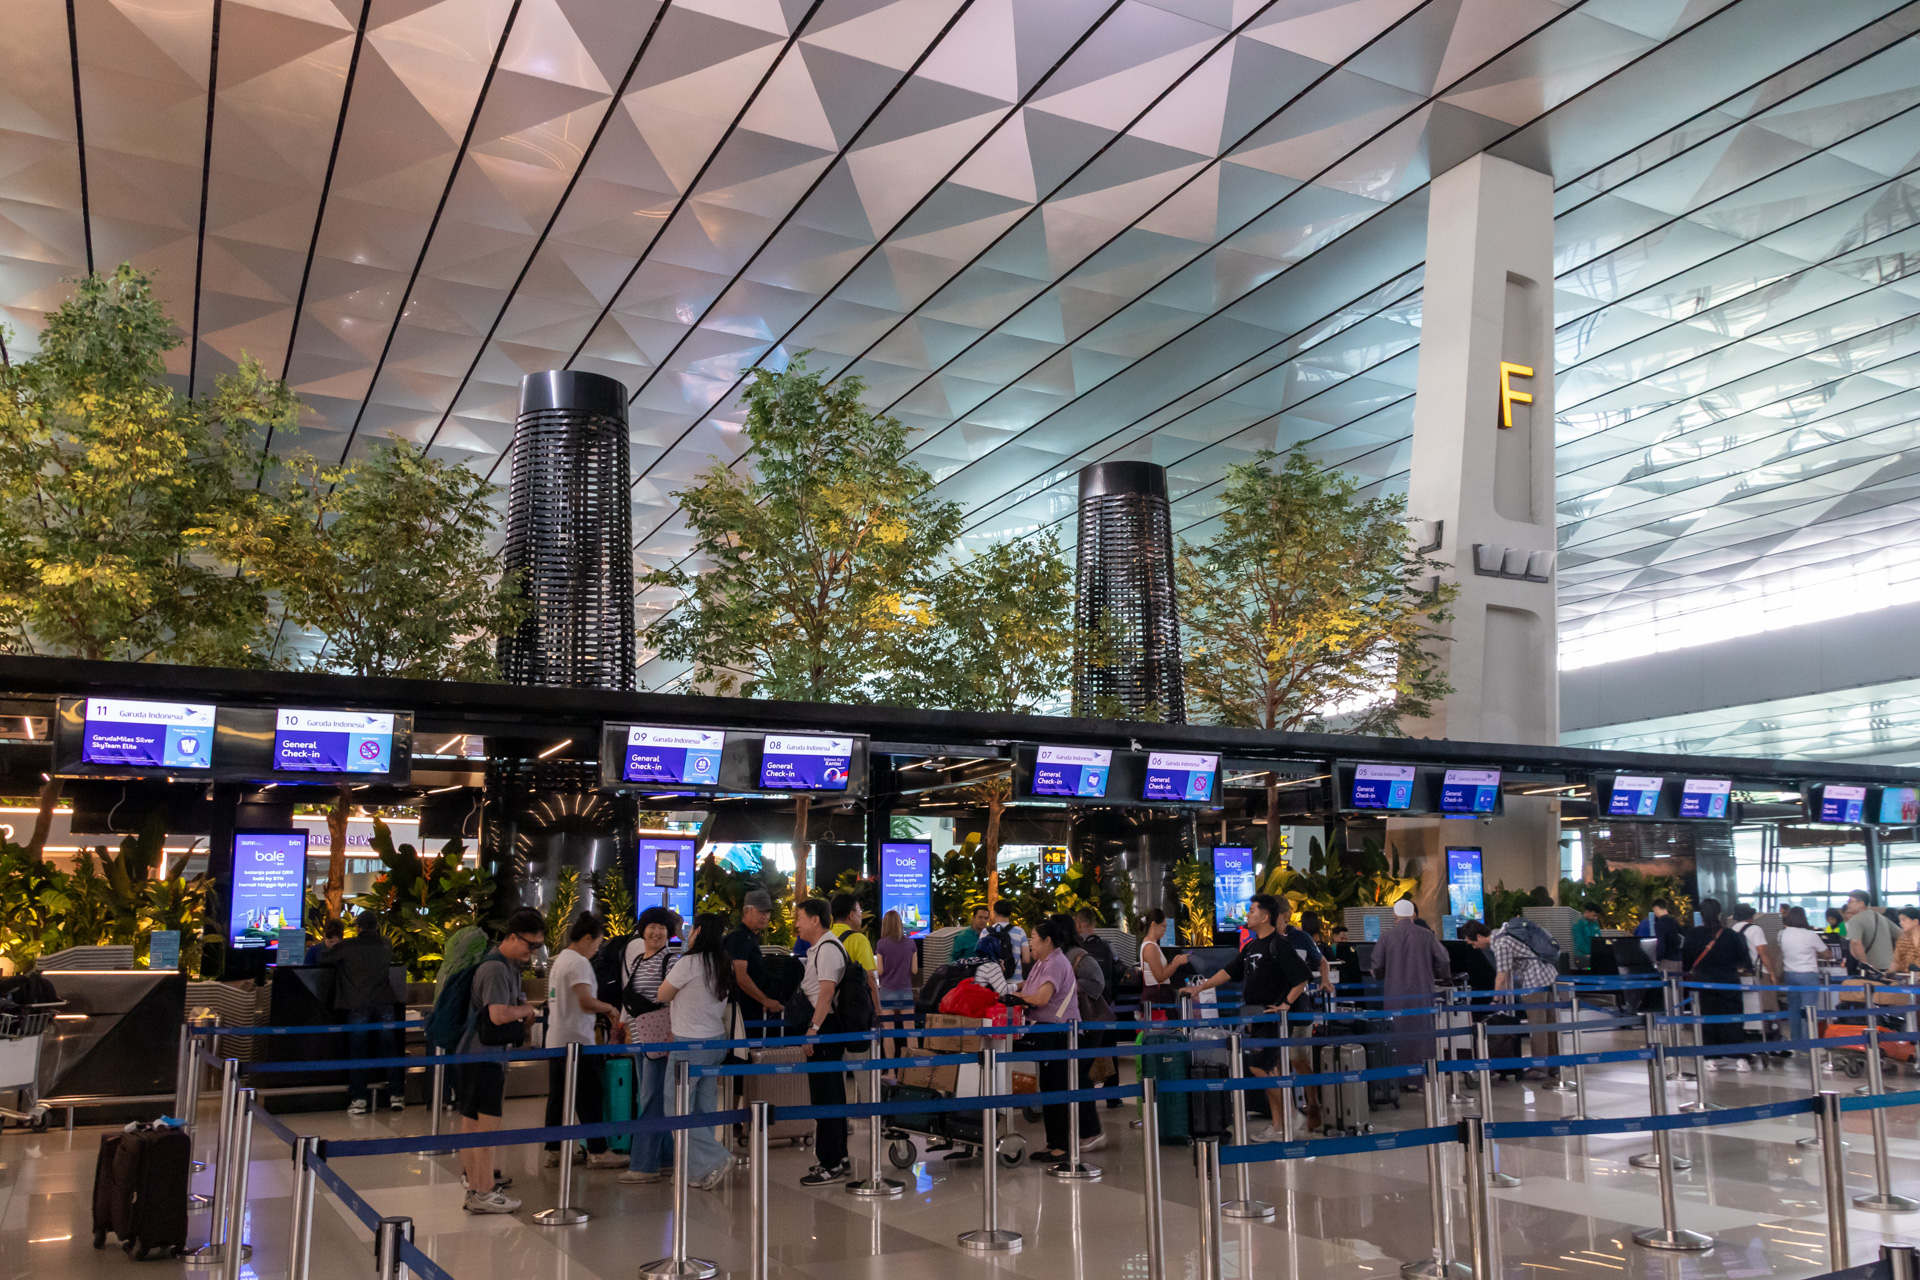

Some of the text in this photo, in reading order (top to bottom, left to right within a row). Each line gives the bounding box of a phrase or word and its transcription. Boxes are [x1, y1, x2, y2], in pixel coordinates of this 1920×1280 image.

[1499, 361, 1534, 428] F
[97, 705, 108, 716] 11
[119, 710, 184, 721] Garuda Indonesia
[285, 716, 299, 726] 10
[307, 719, 365, 729] Garuda Indonesia
[92, 734, 155, 744] GarudaMiles Silver
[633, 732, 648, 742] 09
[652, 735, 700, 745] Garuda Indonesia
[91, 742, 121, 750] SkyTeam
[282, 740, 318, 749] General
[769, 740, 782, 750] 08
[806, 744, 831, 752] Indonesia
[281, 749, 320, 758] Check-in
[1041, 751, 1052, 759] 07
[631, 754, 660, 763] General
[1151, 757, 1162, 766] 06
[630, 762, 662, 771] Check-in
[767, 761, 793, 770] General
[765, 769, 795, 778] Check-in
[1039, 770, 1061, 778] General
[1358, 768, 1368, 776] 05
[1037, 777, 1063, 785] Check-in
[1149, 775, 1170, 783] General
[1447, 773, 1456, 781] 04
[1148, 782, 1172, 790] Check-in
[1356, 785, 1375, 793] General
[255, 850, 285, 862] balé
[895, 856, 917, 867] balé
